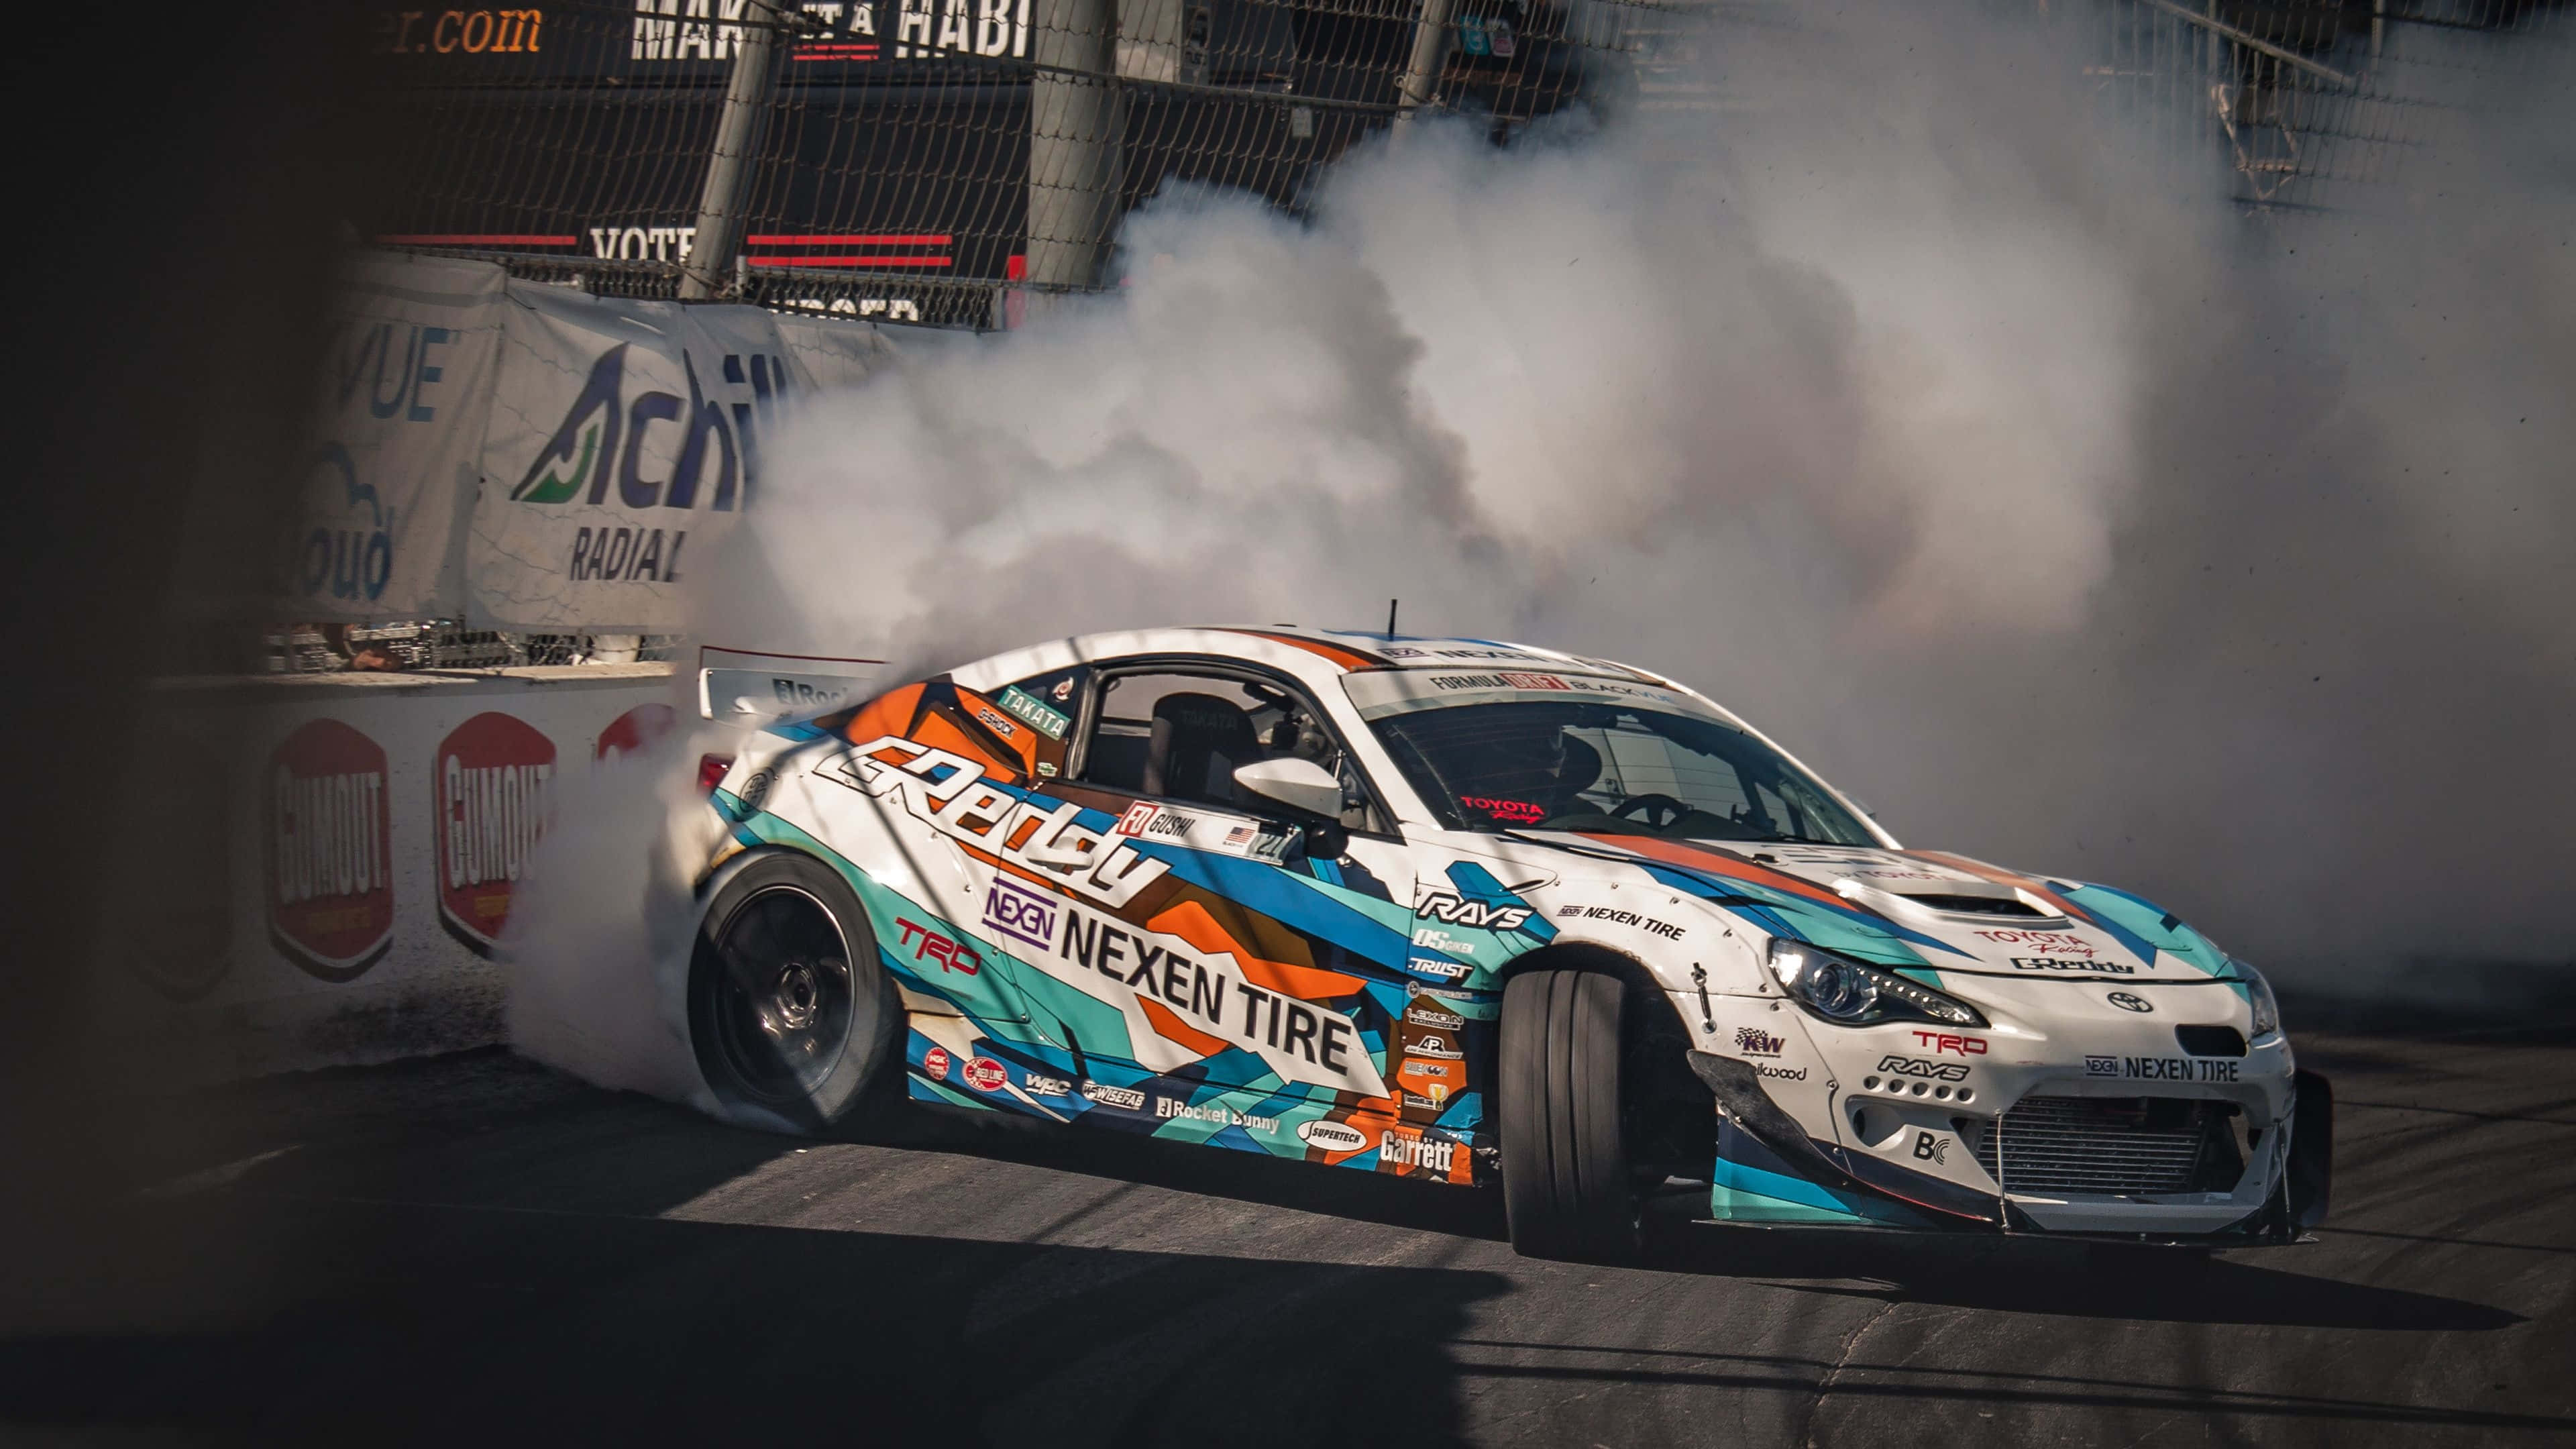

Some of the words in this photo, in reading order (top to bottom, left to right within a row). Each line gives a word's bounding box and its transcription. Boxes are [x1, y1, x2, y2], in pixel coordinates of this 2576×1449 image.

[631, 0, 746, 60] MAK
[847, 3, 876, 39] A
[894, 0, 1034, 58] HABI
[570, 526, 688, 582] RADIAL
[1430, 675, 1511, 690] FORMULA
[1503, 674, 1570, 690] DRIFT
[977, 708, 1017, 739] G-SHOCK
[1003, 688, 1065, 737] TAKATA
[1460, 796, 1545, 815] TOYOTA
[1149, 813, 1196, 837] GUSHI
[1417, 893, 1535, 928] RAYS
[1583, 907, 1642, 926] NEXEN
[1644, 918, 1686, 941] TIRE
[896, 916, 983, 976] TRD
[1413, 928, 1450, 950] OS
[1973, 931, 2092, 947] TOYOTA
[2028, 944, 2099, 958] Racing
[1409, 957, 1473, 978] TRUST
[2010, 958, 2135, 974] GReddy
[983, 882, 1057, 946] NEXEN
[1062, 909, 1226, 1024] NEXEN
[1236, 981, 1351, 1076] TIRE
[1407, 1008, 1464, 1025] LEXON
[1743, 1035, 1786, 1053] KW
[1913, 1030, 1988, 1057] TRD
[1878, 1055, 1970, 1082] RAYS
[2085, 1057, 2118, 1075] NEXEN
[2125, 1057, 2193, 1081] NEXEN
[2198, 1060, 2239, 1082] TIRE
[1095, 1087, 1145, 1107] WISEFAB
[1173, 1101, 1228, 1124] Rocket
[1232, 1111, 1281, 1134] Bunny
[1311, 1126, 1361, 1144] SUPERTECH
[1380, 1130, 1453, 1172] Garrett
